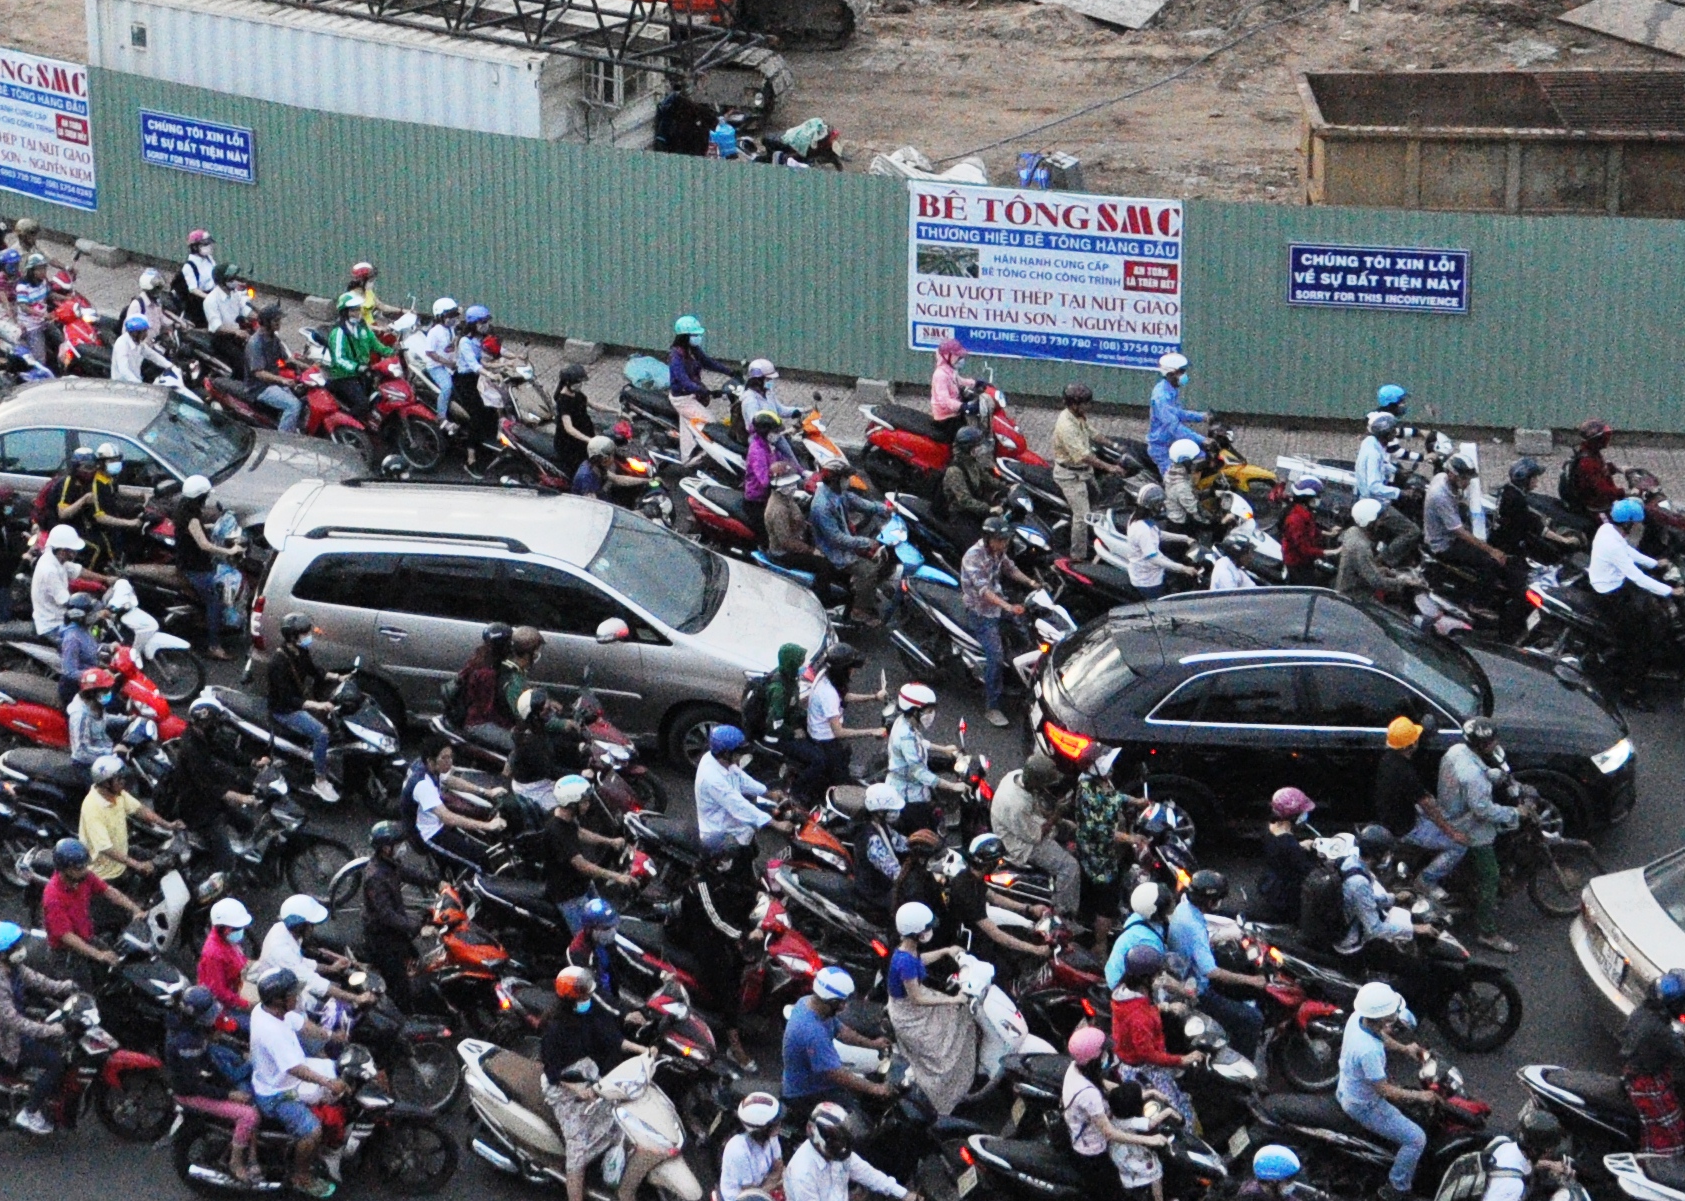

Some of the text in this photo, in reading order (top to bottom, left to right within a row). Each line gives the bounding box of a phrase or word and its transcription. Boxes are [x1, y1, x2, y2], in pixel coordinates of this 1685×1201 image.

[37, 63, 86, 97] SMC
[147, 119, 244, 147] CHÚNG TÔI XIN LỖI
[160, 137, 175, 151] SỰ
[177, 139, 197, 153] BẤT
[199, 145, 224, 159] TIỆN
[226, 150, 248, 164] NÀY
[917, 189, 1180, 237] BÊ TÔNG SMC
[919, 225, 1176, 257] THƯƠNG HIỆU BÊ TÔNG HÀNG ĐẦU
[994, 254, 1017, 264] HÂN
[1054, 259, 1084, 270] CUNG
[1087, 261, 1109, 271] CẤP
[1300, 252, 1456, 272] CHÚNG TÔI XIN LỖI
[982, 266, 1121, 286] BÊ TÔNG CHO CÔNG TRÌNH
[1320, 271, 1343, 288] SỰ
[1346, 270, 1379, 286] BẤT
[1383, 274, 1422, 291] TIỆN
[1426, 277, 1462, 291] NÀY
[916, 278, 1178, 316] CẦU VƯỢT THÉP TẠI NÚT GIAO
[1295, 289, 1459, 307] SORRY FOR THIS INCONVIENCE
[923, 327, 949, 338] SMC
[983, 307, 1019, 323] THÁI
[1024, 311, 1056, 326] SƠN
[1142, 320, 1178, 338] KIỆM
[970, 329, 1019, 342] HOTLINE:
[1021, 334, 1046, 344] 0903
[1049, 336, 1069, 346] 730
[1123, 342, 1149, 352] 3754
